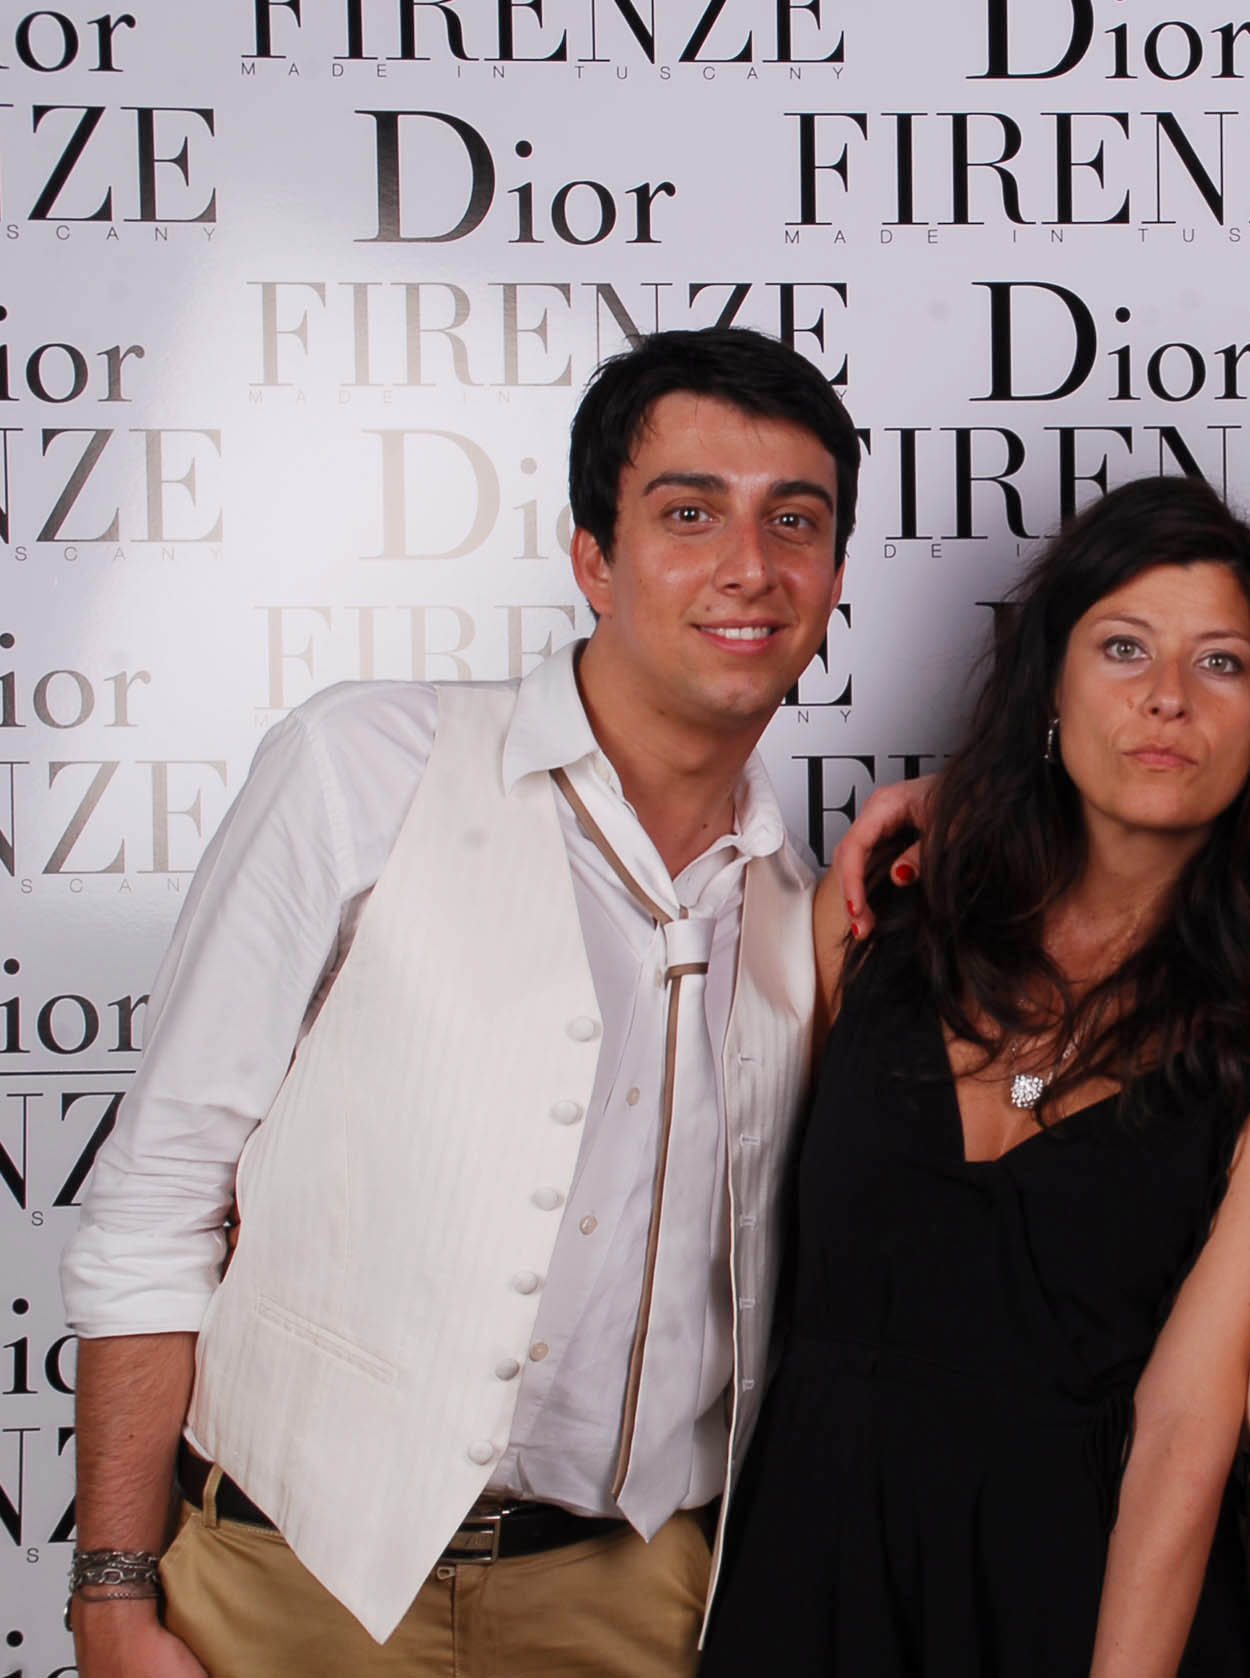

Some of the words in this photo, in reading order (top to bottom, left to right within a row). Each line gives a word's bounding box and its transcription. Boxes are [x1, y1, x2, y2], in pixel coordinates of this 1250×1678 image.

[0, 10, 136, 72] or
[241, 0, 845, 64] FIRENZE
[240, 62, 388, 78] MADE
[457, 65, 505, 79] IN
[575, 65, 844, 81] TUSCANY
[353, 109, 676, 246] Dior
[784, 228, 939, 244] MADE
[1013, 228, 1064, 243] IN
[248, 389, 392, 405] MADE
